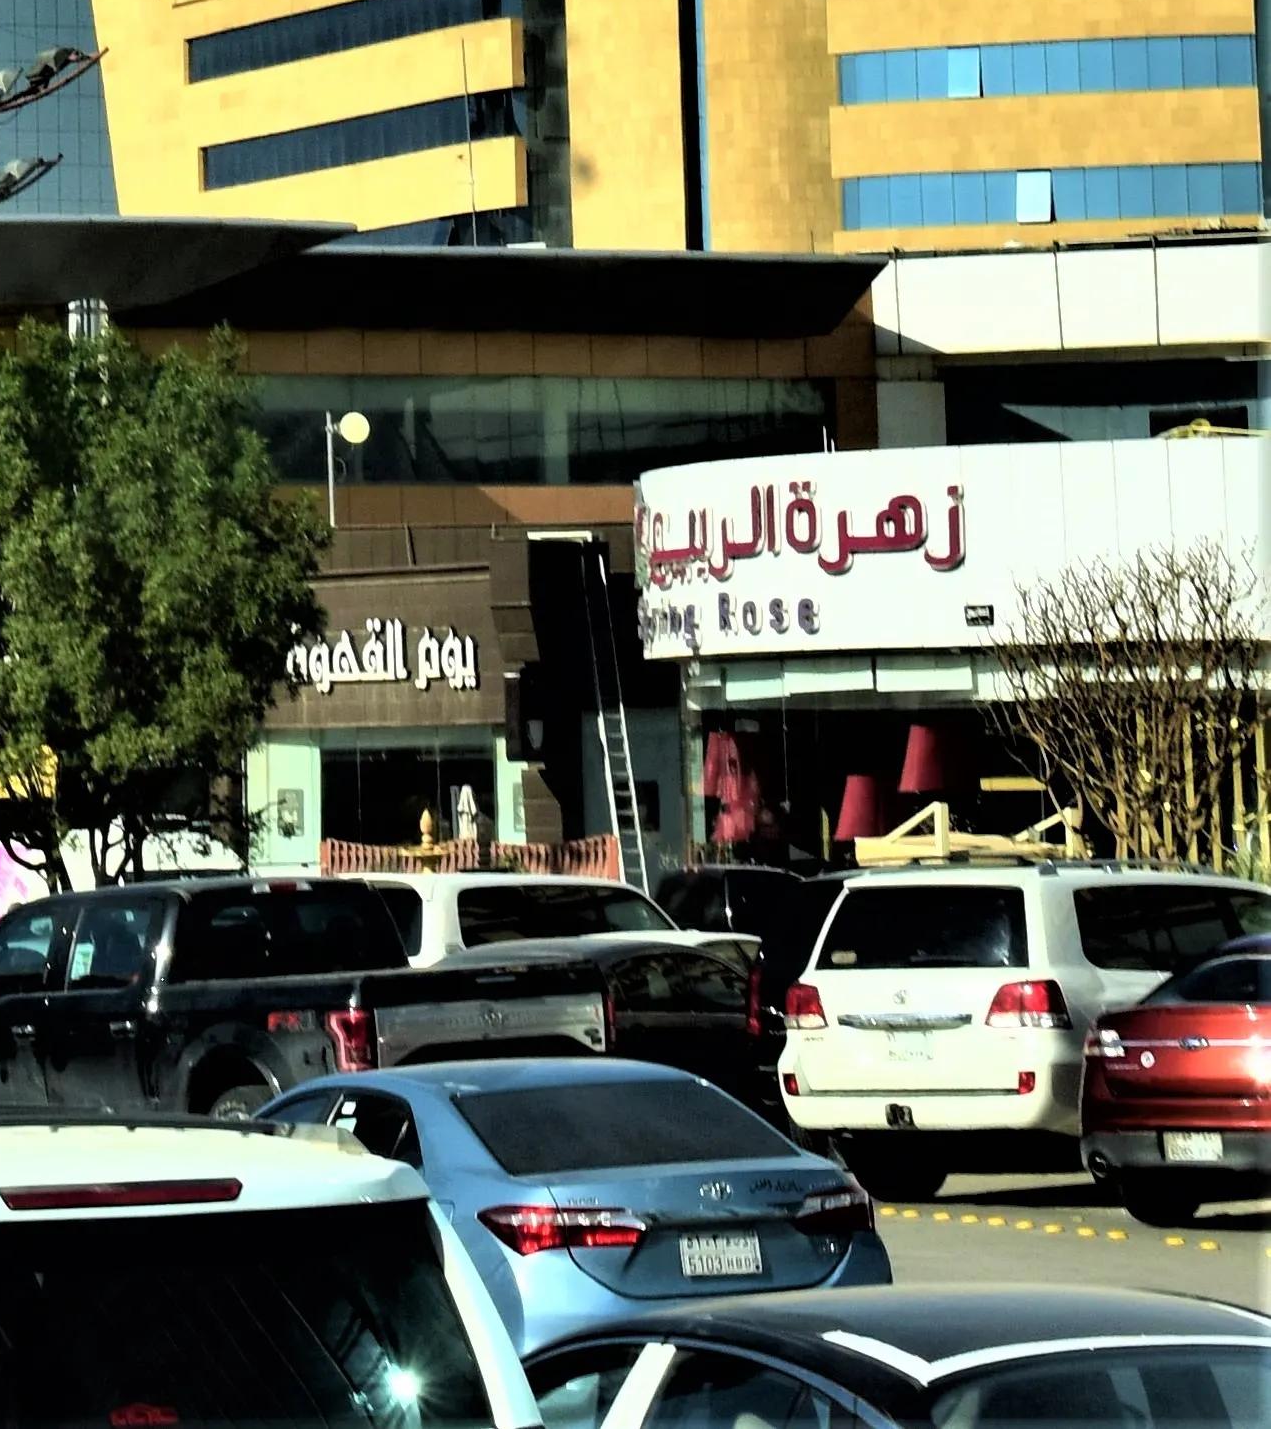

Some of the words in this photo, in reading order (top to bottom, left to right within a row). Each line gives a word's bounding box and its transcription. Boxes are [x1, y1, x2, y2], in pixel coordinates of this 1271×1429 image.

[785, 480, 965, 573] زهرة
[718, 592, 820, 635] Rose
[414, 626, 477, 691] يوم
